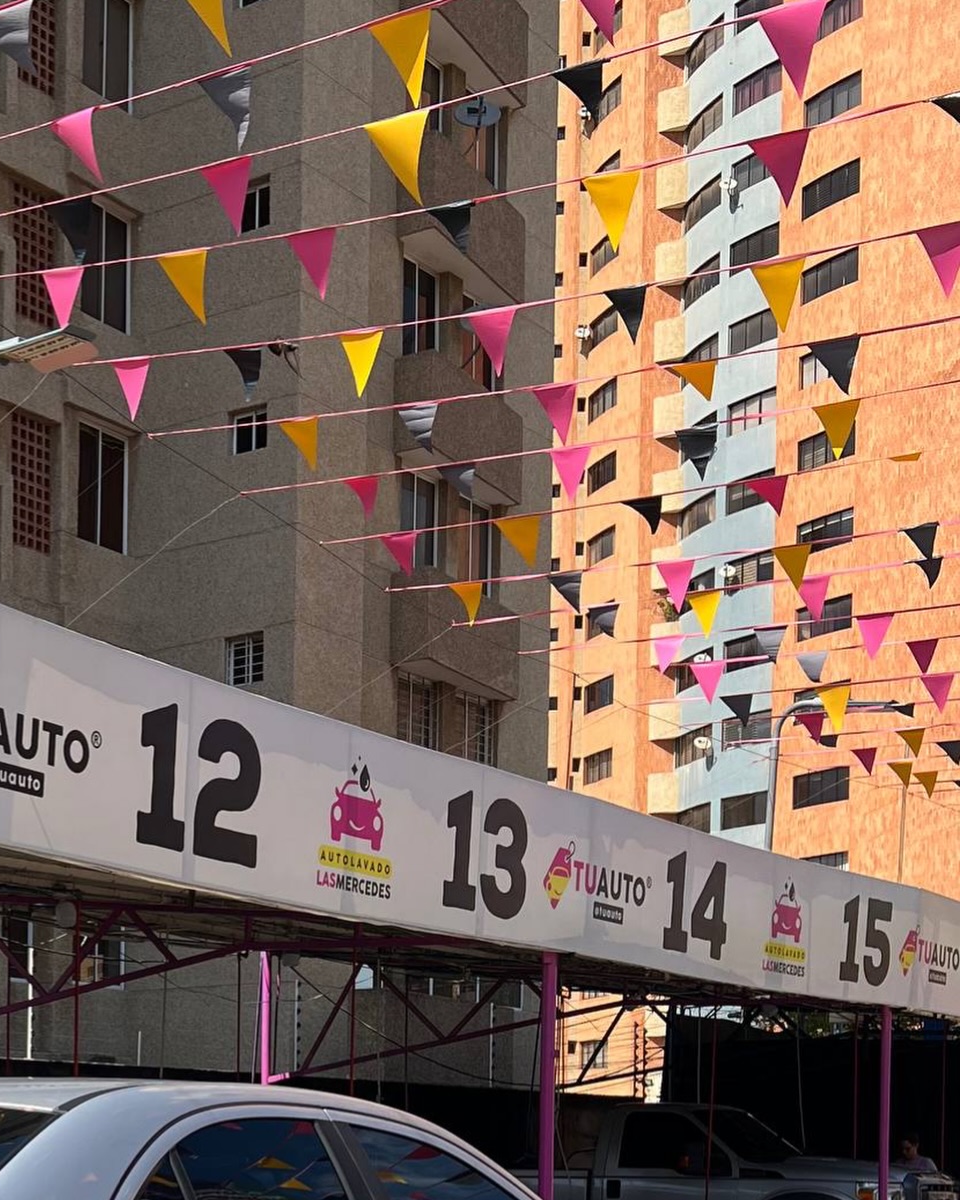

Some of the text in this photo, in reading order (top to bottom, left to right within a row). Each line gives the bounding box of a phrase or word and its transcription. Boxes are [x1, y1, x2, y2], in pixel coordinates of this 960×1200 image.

[136, 702, 262, 869] 12
[320, 850, 391, 875] AUTOLAVADO
[442, 790, 528, 919] 13
[663, 850, 727, 961] 14
[839, 894, 893, 987] 15
[918, 938, 960, 971] TUAUTO
